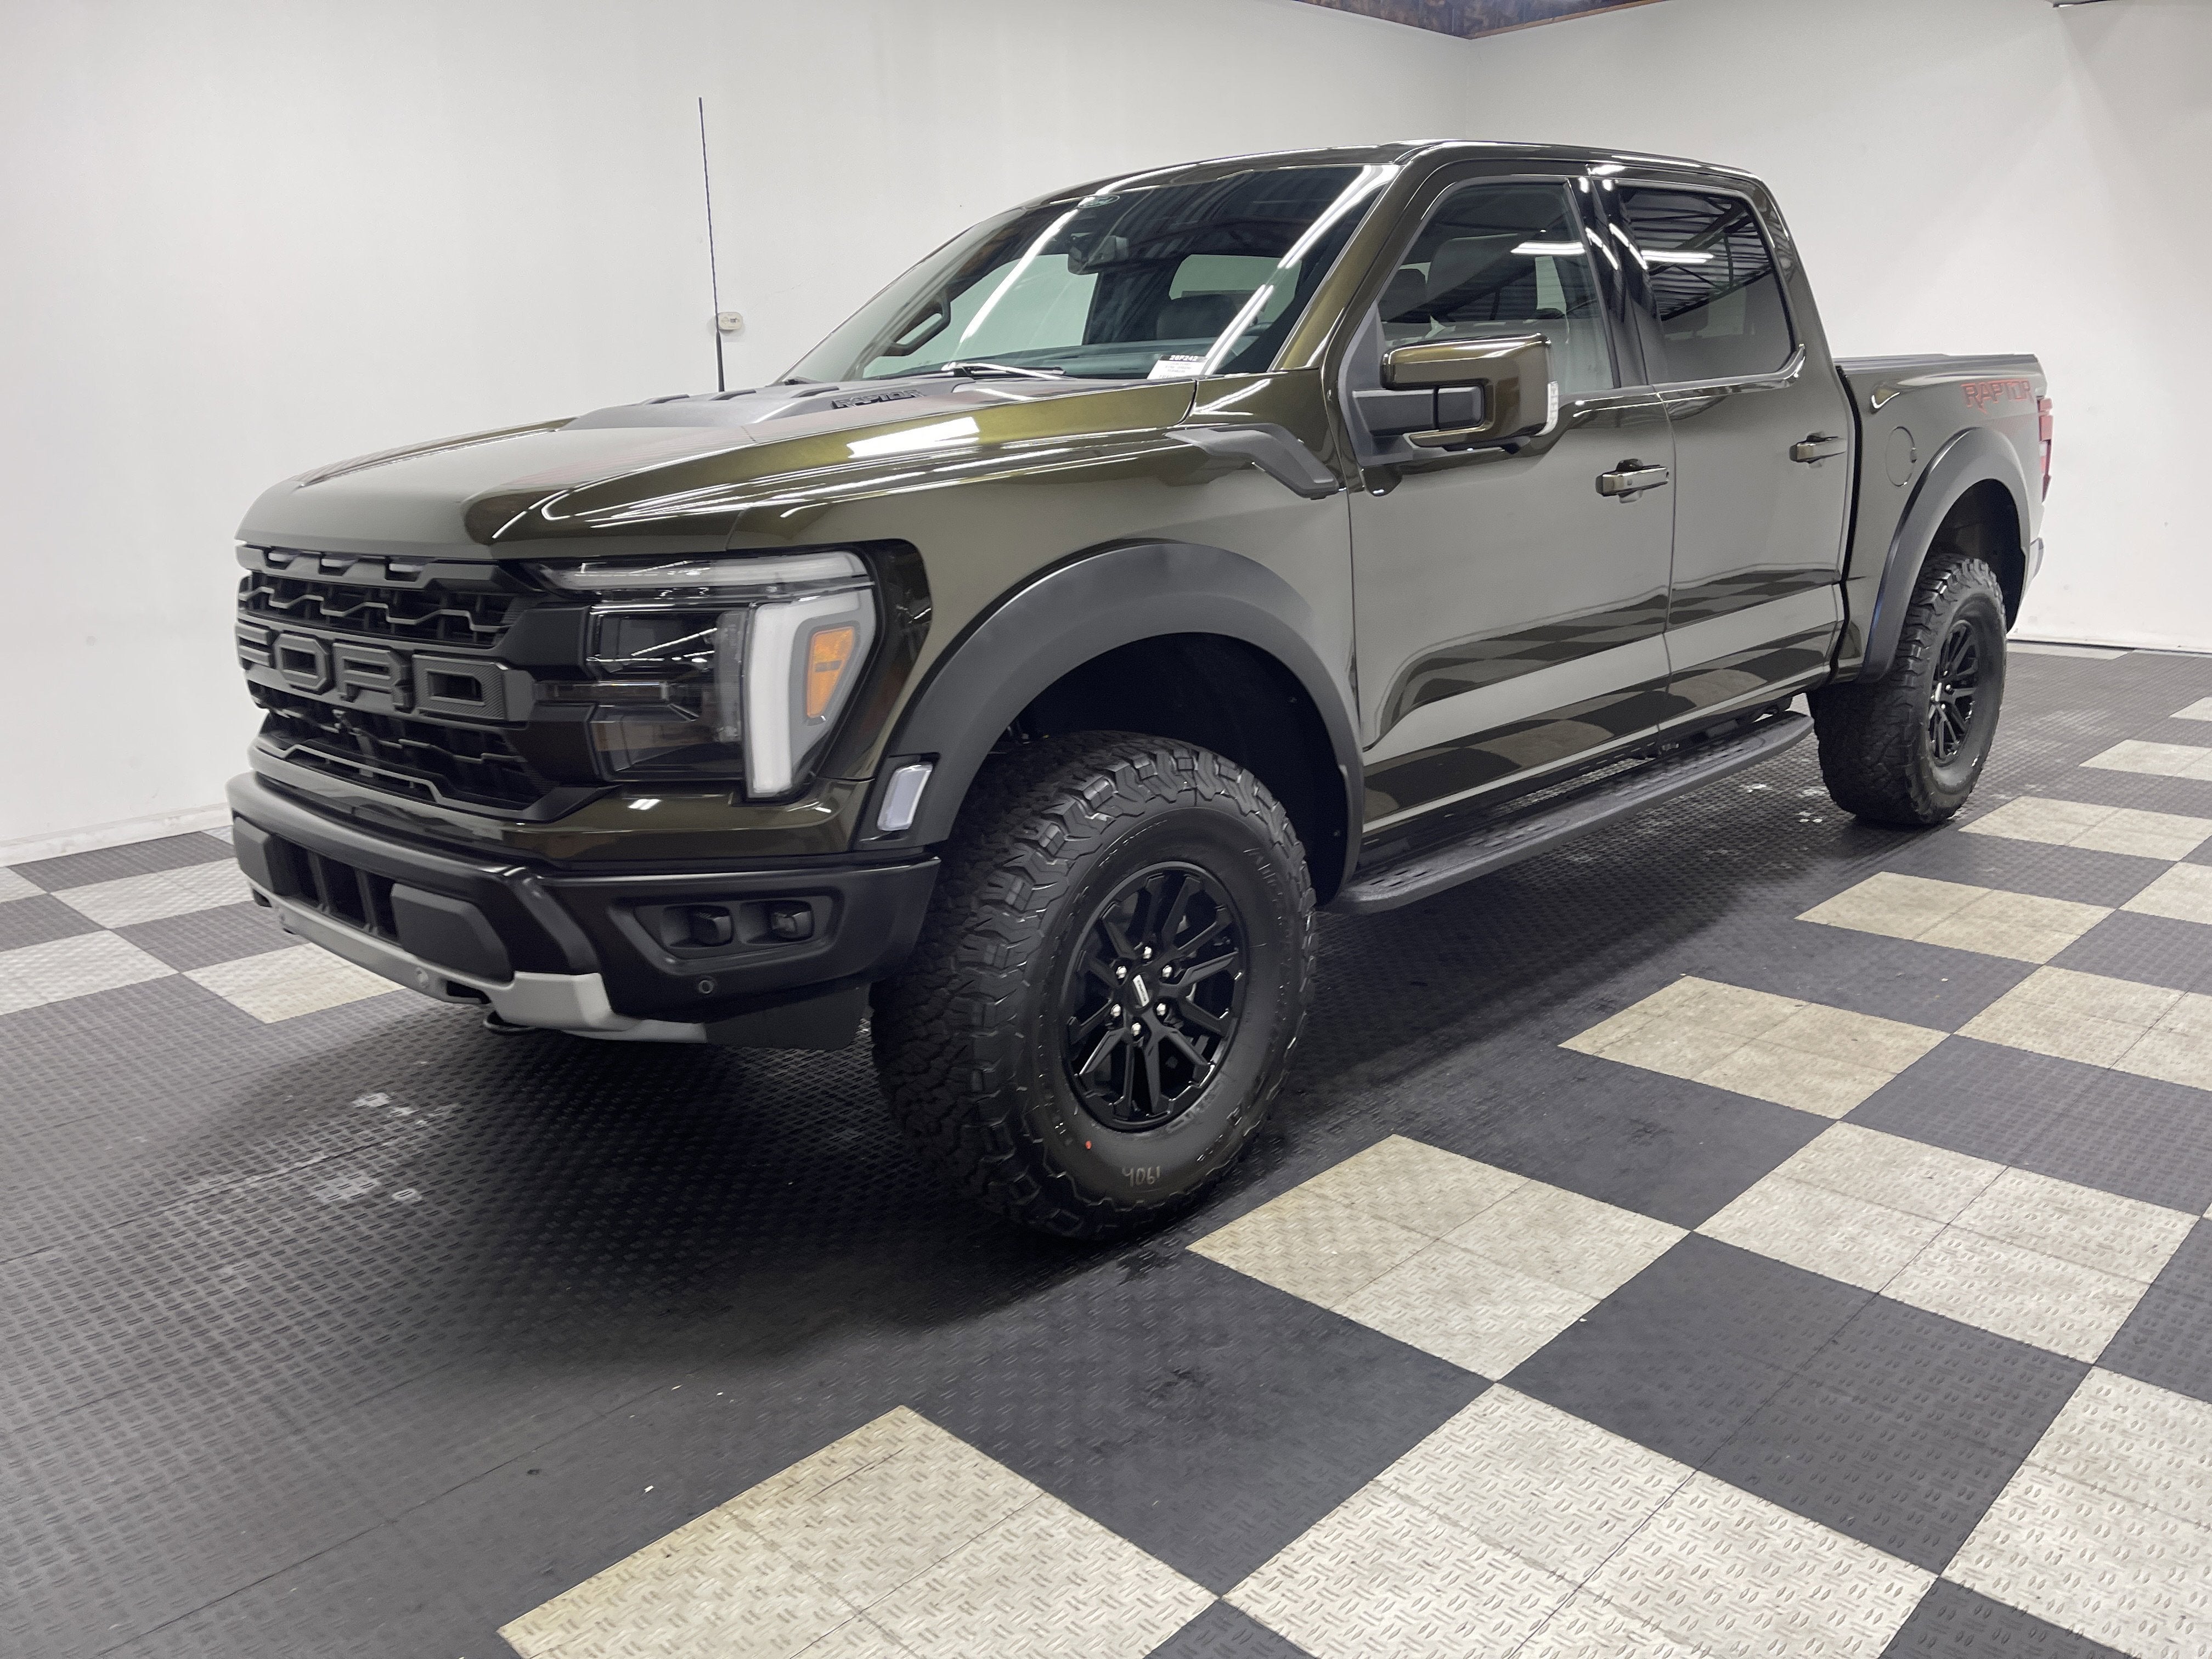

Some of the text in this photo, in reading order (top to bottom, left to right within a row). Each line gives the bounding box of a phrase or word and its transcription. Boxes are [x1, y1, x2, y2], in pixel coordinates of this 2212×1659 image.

[831, 390, 926, 409] RAPTOR
[1961, 377, 2034, 414] RAPTOR
[234, 621, 509, 720] FORD
[1122, 1165, 1160, 1187] 4061
